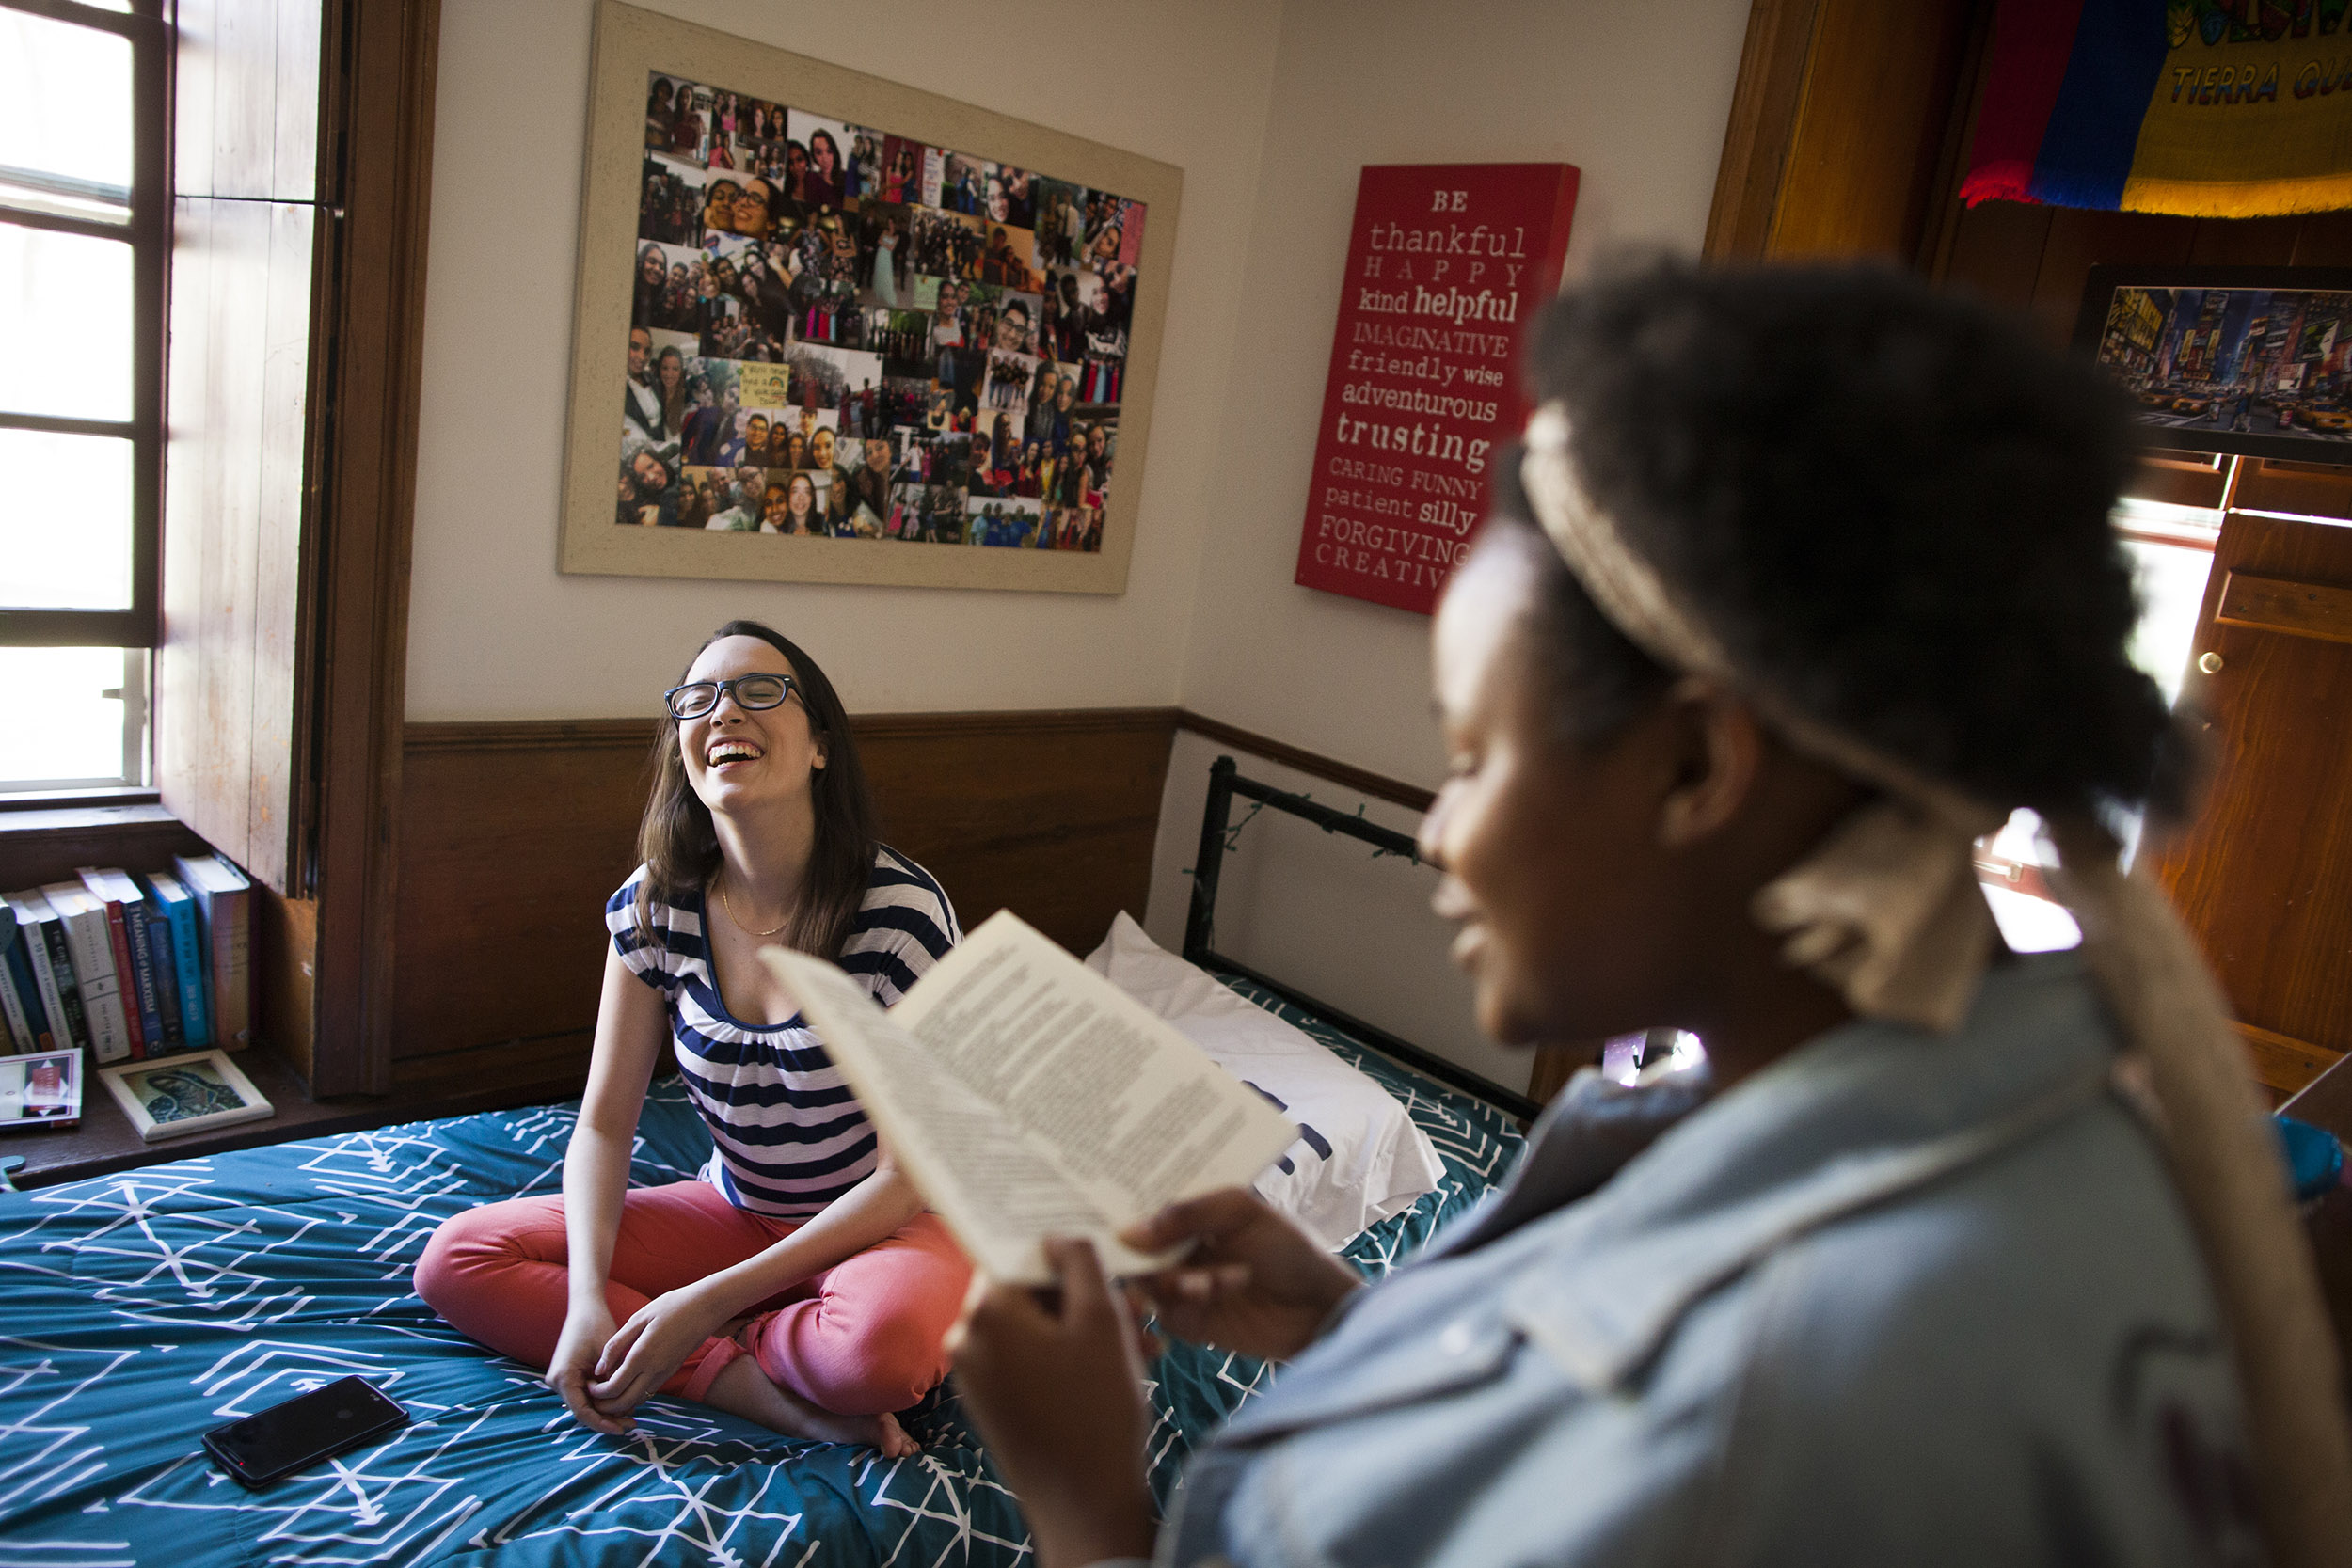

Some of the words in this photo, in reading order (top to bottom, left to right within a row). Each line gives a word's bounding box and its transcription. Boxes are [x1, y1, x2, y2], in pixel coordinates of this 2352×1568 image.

[2171, 62, 2280, 105] TIERRA
[1431, 190, 1469, 213] BE
[1370, 221, 1526, 259] thankful
[1364, 255, 1524, 287] HAPPY
[1358, 287, 1409, 314] kind
[1413, 284, 1518, 326] helpful
[1352, 321, 1509, 358] IMAGINATIVE
[1348, 349, 1457, 387] friendly
[1463, 365, 1504, 387] wise
[1342, 381, 1498, 422] adventurous
[1337, 411, 1490, 473] trusting
[1328, 456, 1404, 487] CARING
[1410, 470, 1483, 500] FUNNY
[1324, 487, 1413, 518] patient
[1418, 500, 1478, 536] silly
[1319, 514, 1470, 566] FORGIVING
[1315, 543, 1449, 590] CREATIV
[131, 913, 149, 959] MEANING
[139, 967, 156, 1014] MARXISM
